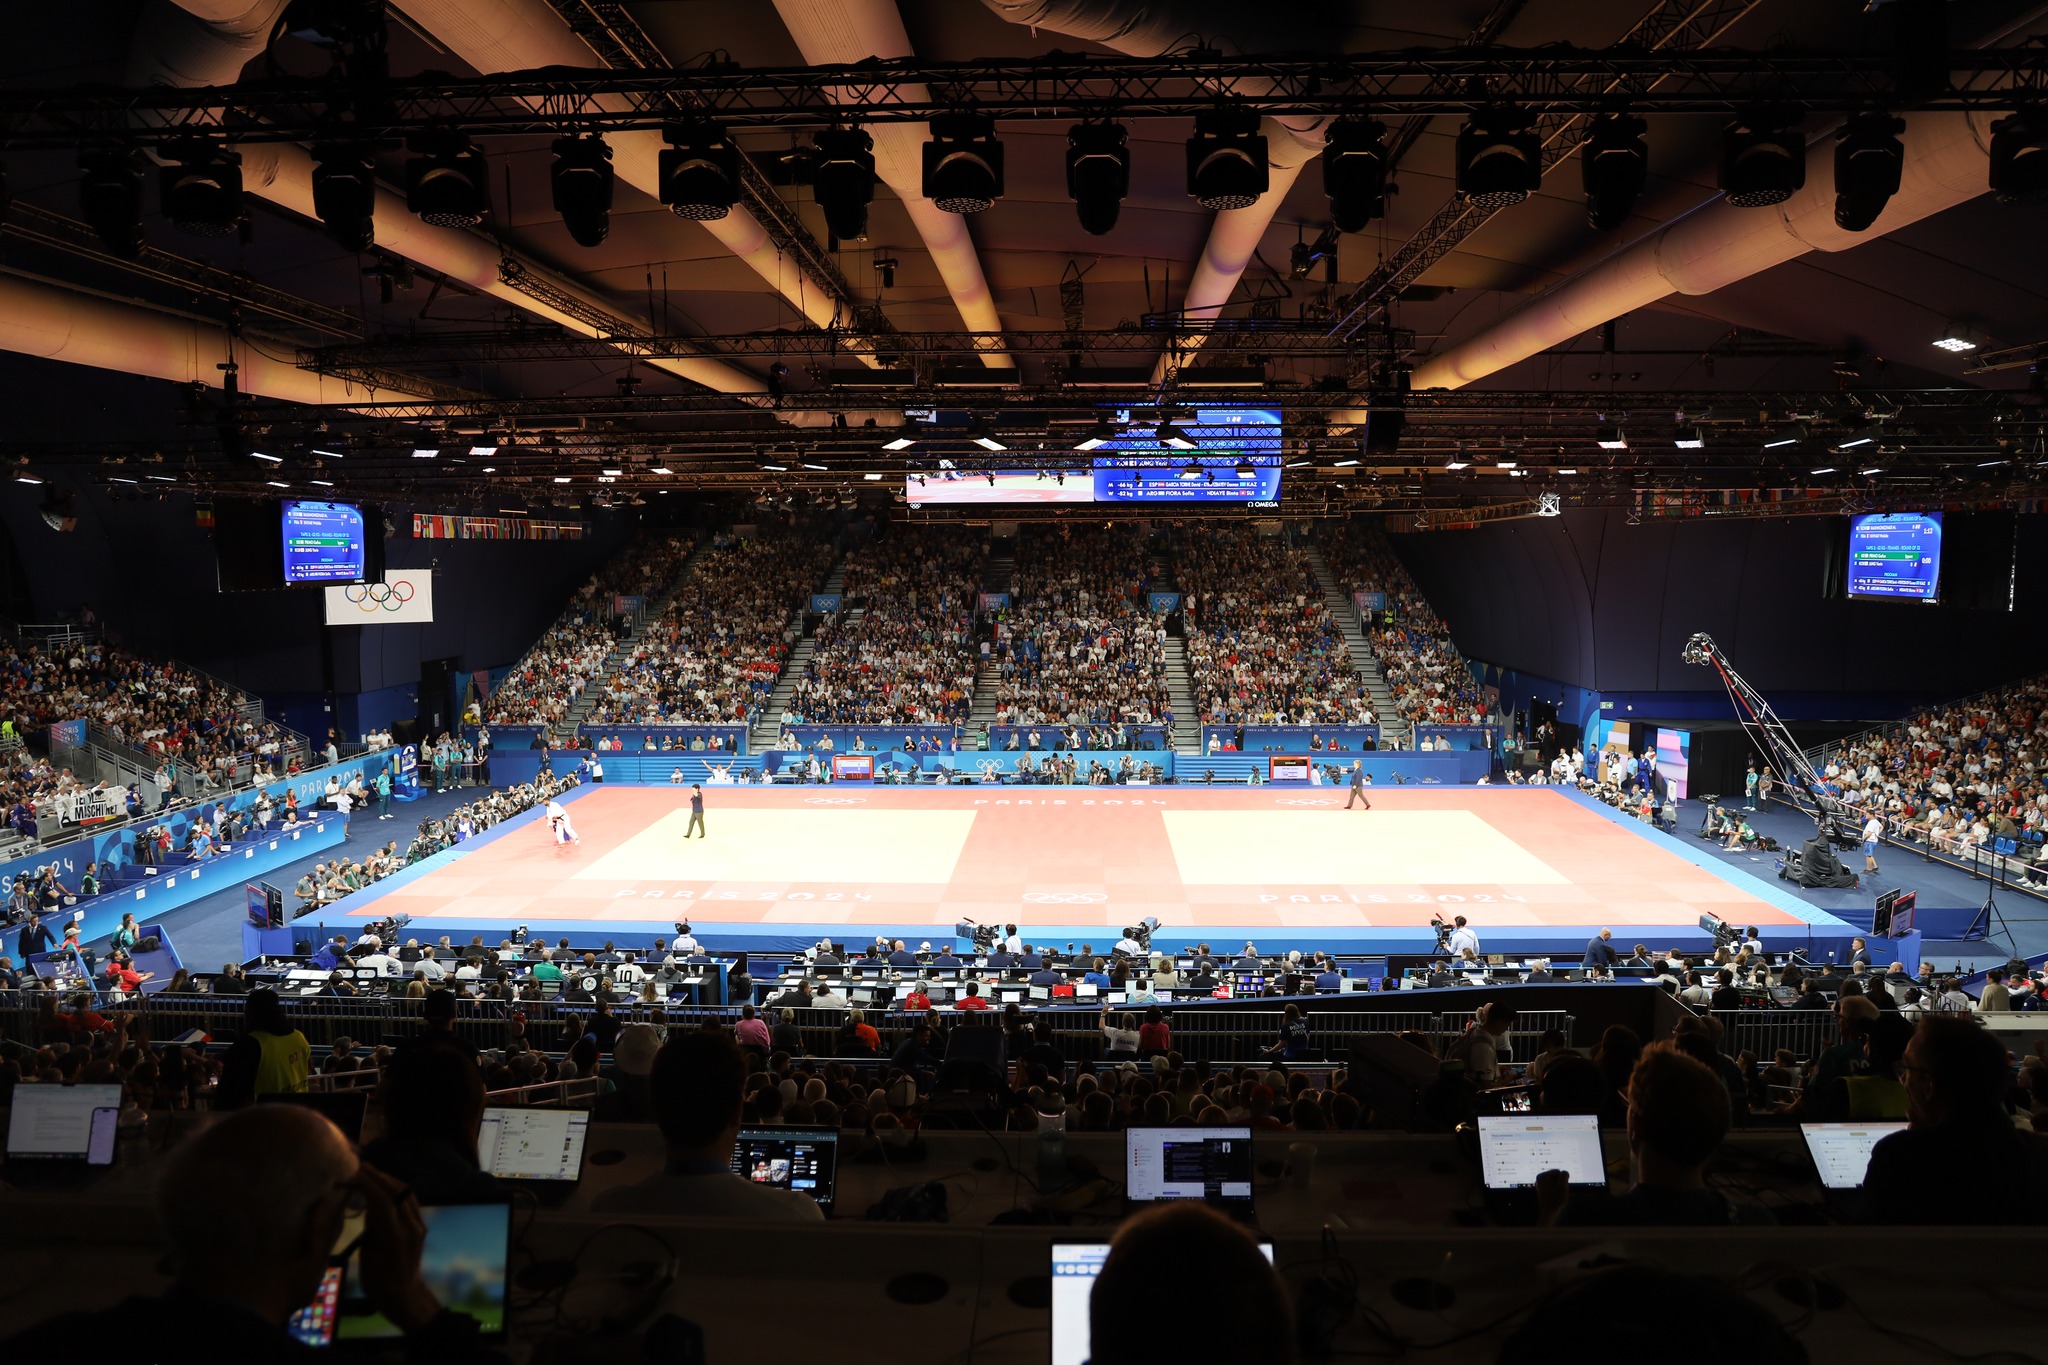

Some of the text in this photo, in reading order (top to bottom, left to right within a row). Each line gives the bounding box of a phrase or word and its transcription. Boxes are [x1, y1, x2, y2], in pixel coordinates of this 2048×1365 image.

[614, 889, 873, 901] PARIS 2024
[1258, 893, 1528, 904] PARIS 2024
[620, 970, 632, 982] 10
